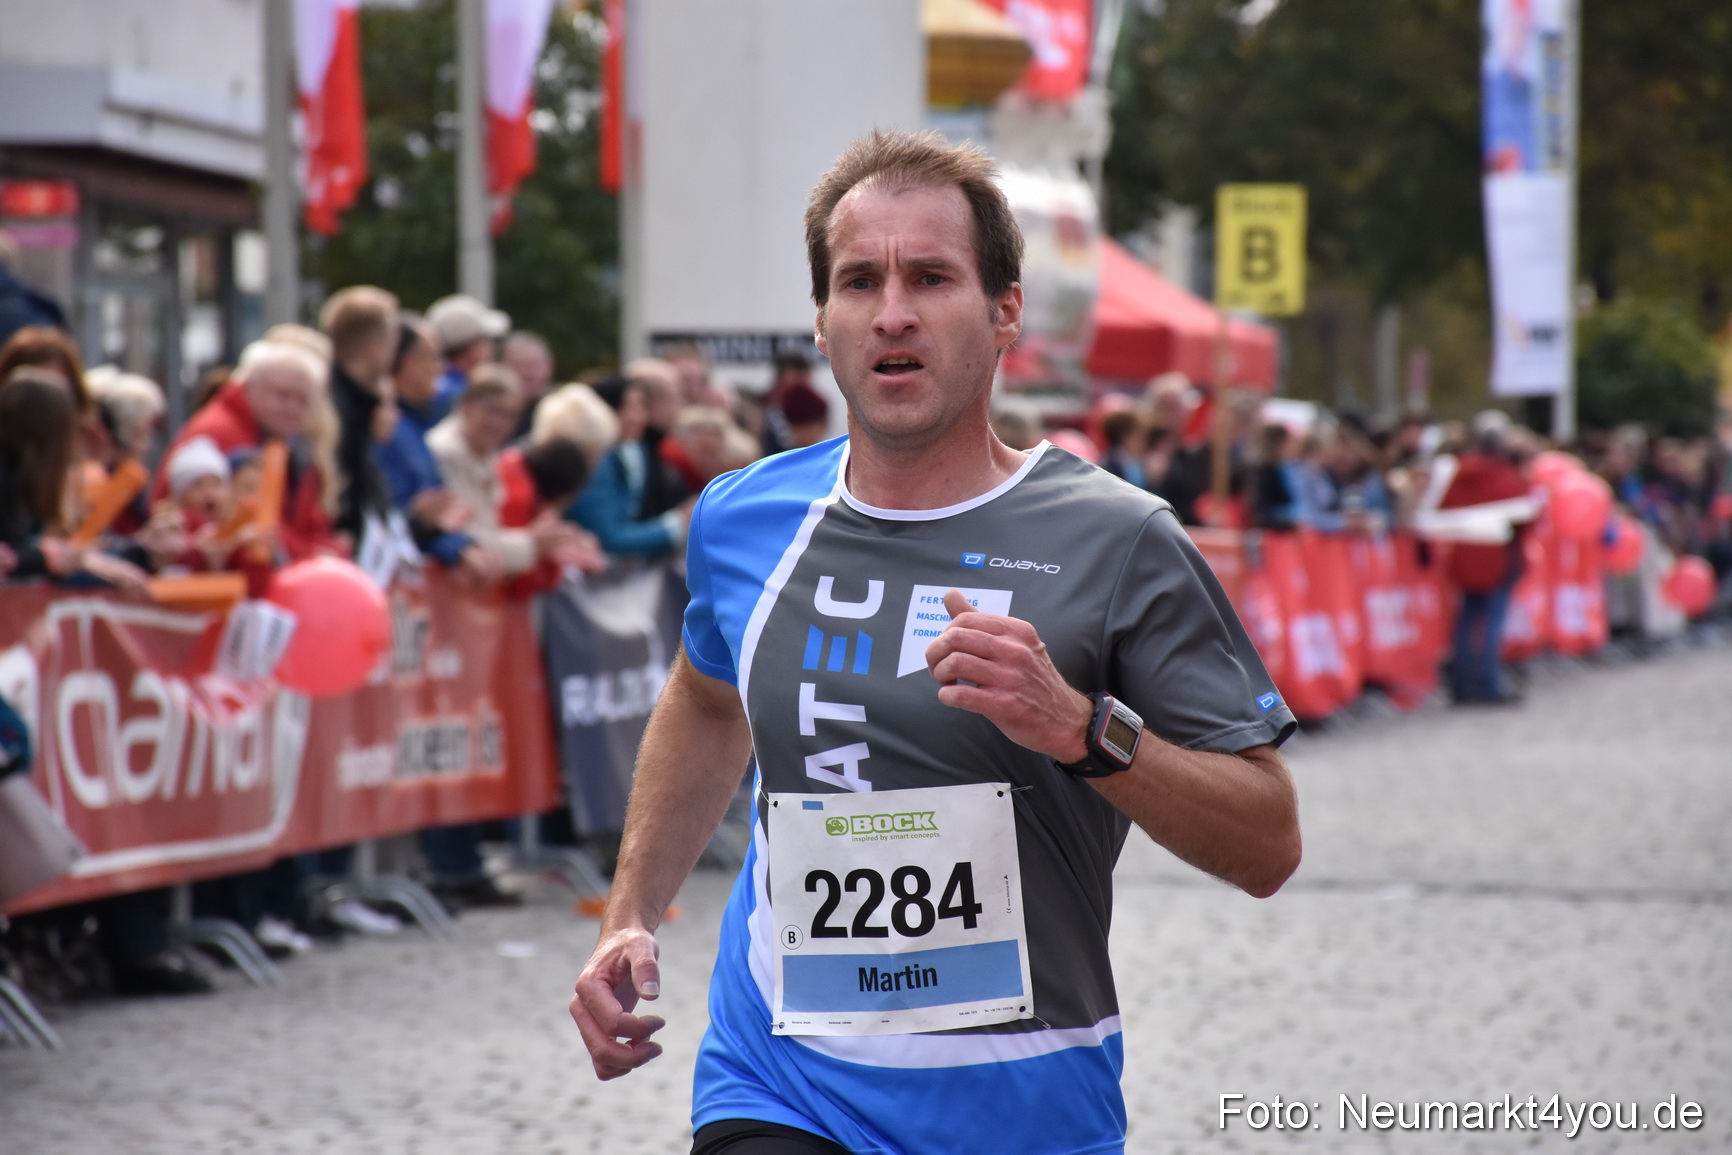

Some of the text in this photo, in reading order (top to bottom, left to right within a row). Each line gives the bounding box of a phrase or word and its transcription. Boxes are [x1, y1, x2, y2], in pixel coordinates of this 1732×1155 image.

[1239, 225, 1281, 285] B
[850, 811, 938, 835] BOCK
[852, 834, 879, 843] inspired
[880, 834, 888, 842] by
[910, 831, 940, 840] concepts
[804, 861, 983, 939] 2284
[788, 931, 797, 944] B
[858, 963, 938, 993] Martin
